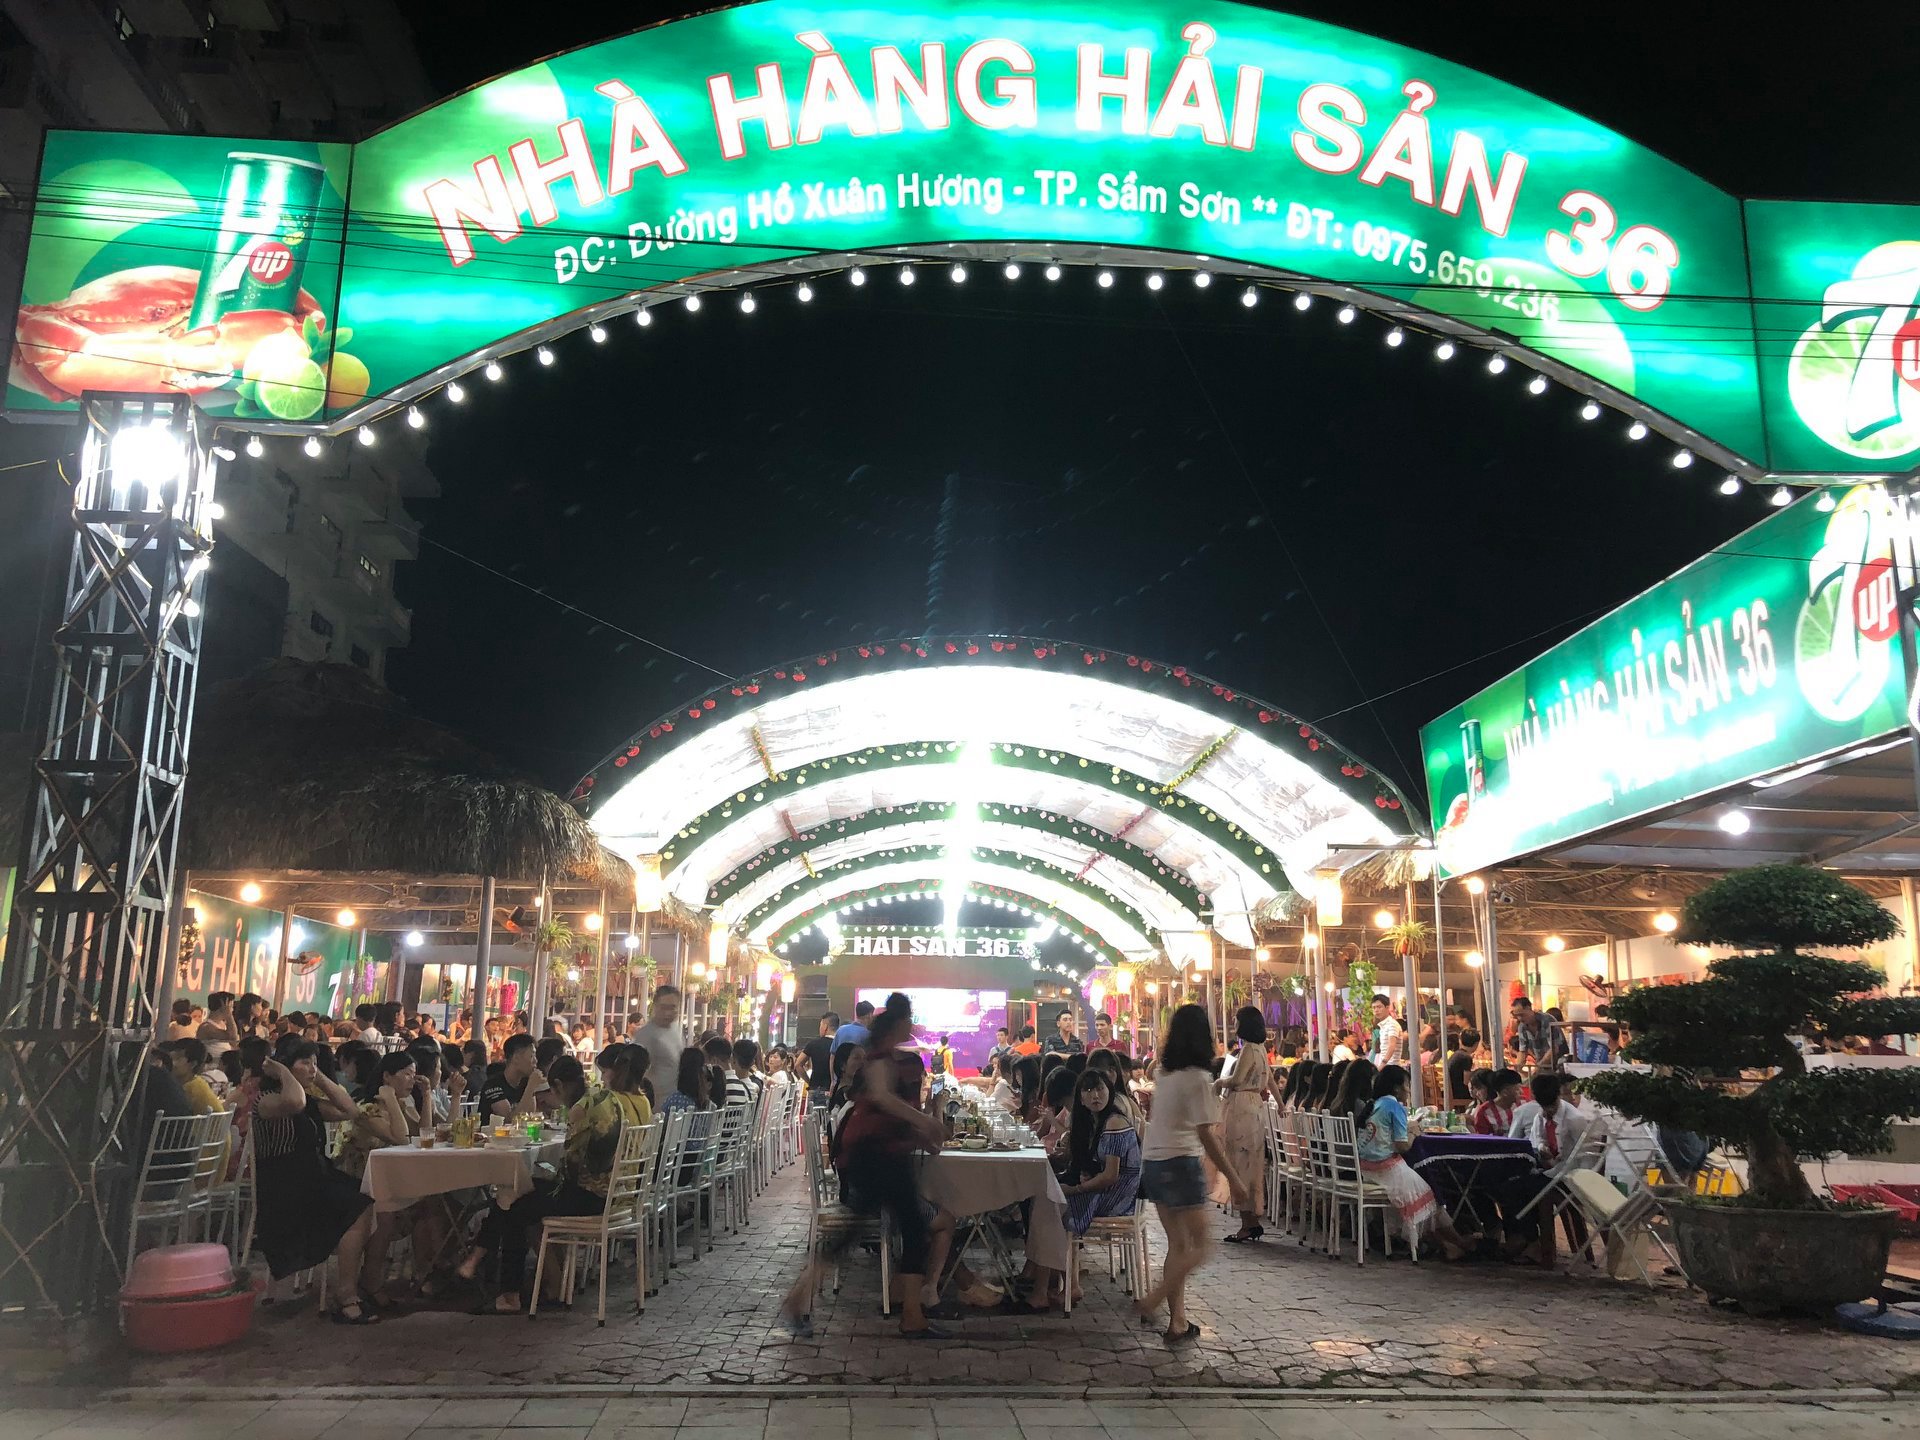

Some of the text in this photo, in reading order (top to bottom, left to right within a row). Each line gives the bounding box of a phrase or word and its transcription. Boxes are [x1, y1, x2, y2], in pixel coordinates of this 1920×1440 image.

[423, 21, 1679, 312] NHÀ HÀNG HẢI SẢN 36
[554, 235, 617, 284] ĐC:
[628, 206, 738, 259] Đường
[802, 176, 887, 220] Xuân
[897, 172, 1003, 215] Hương
[1034, 169, 1088, 208] TP.
[1179, 182, 1241, 225] Sơn
[1286, 201, 1343, 249] ĐT:
[1351, 220, 1561, 324] 0975.659.236
[1663, 599, 1732, 726] SẢN
[1731, 598, 1777, 697] 36
[209, 917, 250, 996] HẢI
[976, 936, 1010, 958] 36
